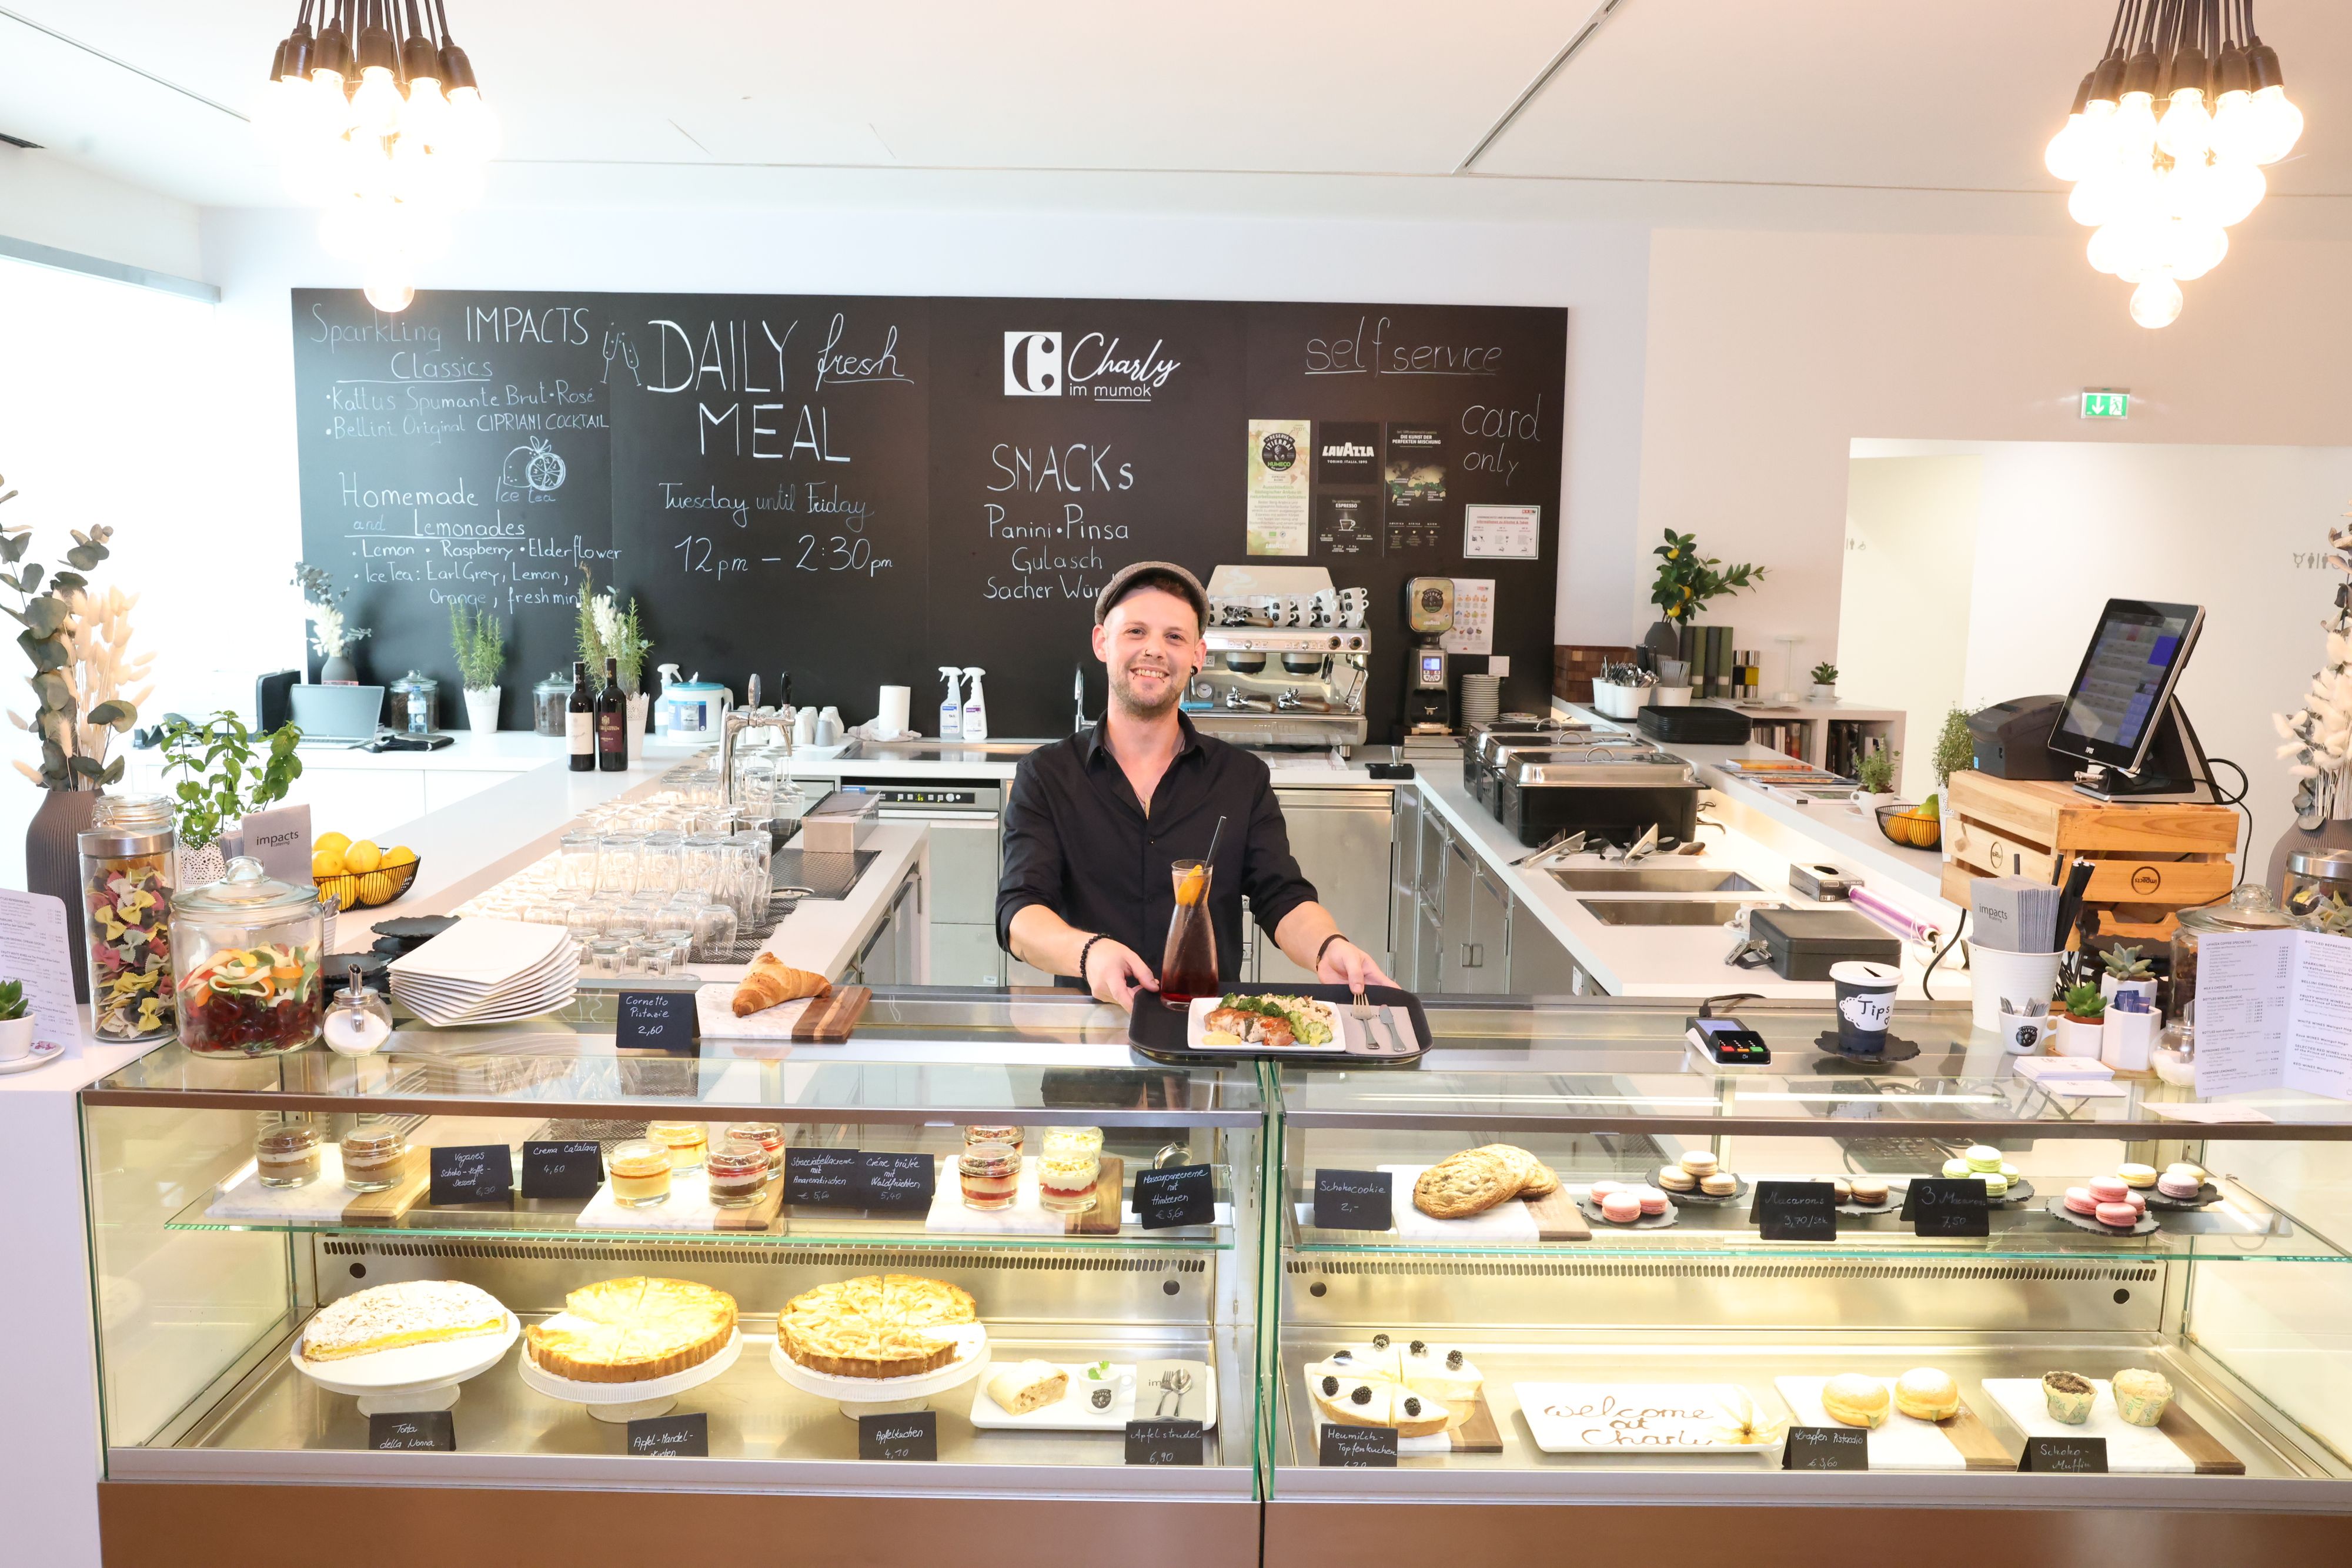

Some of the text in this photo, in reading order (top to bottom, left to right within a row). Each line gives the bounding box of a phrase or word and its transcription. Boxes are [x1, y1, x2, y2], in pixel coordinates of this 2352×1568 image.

[310, 303, 589, 352] Sparkling IMPACTS
[647, 313, 906, 393] DAILY fresh
[1068, 332, 1181, 387] Charly
[1394, 346, 1502, 372] service
[391, 352, 493, 379] Classics
[1070, 383, 1151, 397] im mumok
[410, 386, 500, 416] Spumante
[1462, 393, 1542, 442] card
[334, 413, 610, 446] Bellini Original CIPRIANI COCKTAIL
[699, 402, 851, 462] MEAL
[1322, 442, 1374, 457] LAVAZZA
[1464, 443, 1519, 486] only
[339, 471, 479, 507] Homemade
[659, 482, 875, 533] Tuesday until Friday
[353, 509, 526, 537] and Lemonades
[362, 538, 415, 559] Lemon
[442, 539, 513, 561] Raspberry
[1013, 546, 1102, 574] Gulasch
[983, 576, 1053, 600] Sacher
[507, 587, 550, 614] fresh
[256, 831, 299, 848] impacts
[1979, 903, 2008, 920] impacts
[626, 995, 669, 1006] Cornetto
[630, 1007, 670, 1018] Pistazie
[1857, 1000, 1890, 1021] Tips
[637, 1025, 663, 1036] 2,60
[533, 1146, 557, 1155] Crema
[455, 1152, 485, 1167] Veganes
[543, 1165, 566, 1176] 4,60
[884, 1169, 896, 1178] mit
[453, 1177, 477, 1188] Dessert
[476, 1185, 496, 1196] 6,30
[1167, 1181, 1178, 1191] mit
[1319, 1180, 1386, 1194] Schokocookie
[880, 1191, 901, 1201] 5,40
[1151, 1193, 1188, 1205] Himbeeren
[1765, 1191, 1825, 1205] Macarons
[1921, 1186, 1936, 1205] 3
[392, 1423, 418, 1433] Torta
[1609, 1417, 1650, 1430] at
[379, 1438, 435, 1449] della Nonna
[1795, 1428, 1828, 1446] Krapfen
[885, 1449, 909, 1459] 4,10
[1149, 1451, 1174, 1465] 6,90
